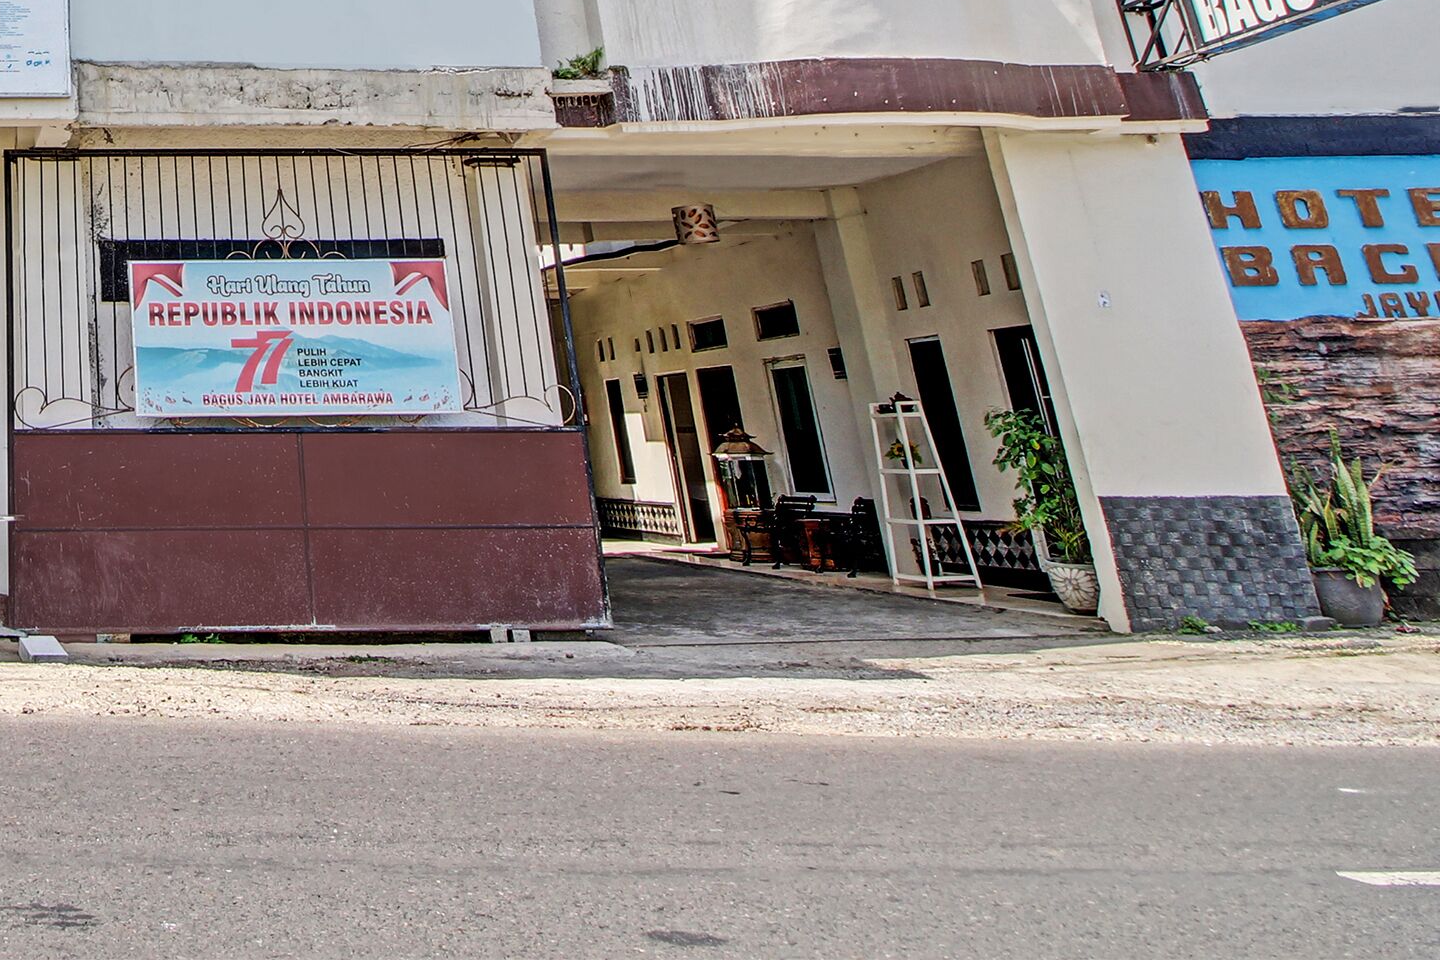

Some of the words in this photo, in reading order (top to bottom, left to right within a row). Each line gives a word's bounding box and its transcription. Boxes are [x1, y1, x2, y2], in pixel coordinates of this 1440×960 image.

[207, 274, 252, 295] Hari
[254, 274, 311, 297] Ulang
[311, 273, 371, 294] Tahun
[1355, 290, 1440, 319] JAY
[148, 301, 281, 326] REPUBLIK
[289, 300, 433, 325] INDONESIA
[297, 348, 327, 357] PULIH
[297, 358, 329, 367] LEBIH
[329, 358, 362, 367] CEPAT
[298, 368, 344, 378] BANGKIT
[299, 379, 331, 388] LEBIH
[332, 379, 359, 388] KUAT
[202, 394, 244, 406] BAGUS
[246, 394, 276, 406] JAYA
[280, 393, 318, 406] HOTEL
[322, 392, 394, 406] AMBARAWA
